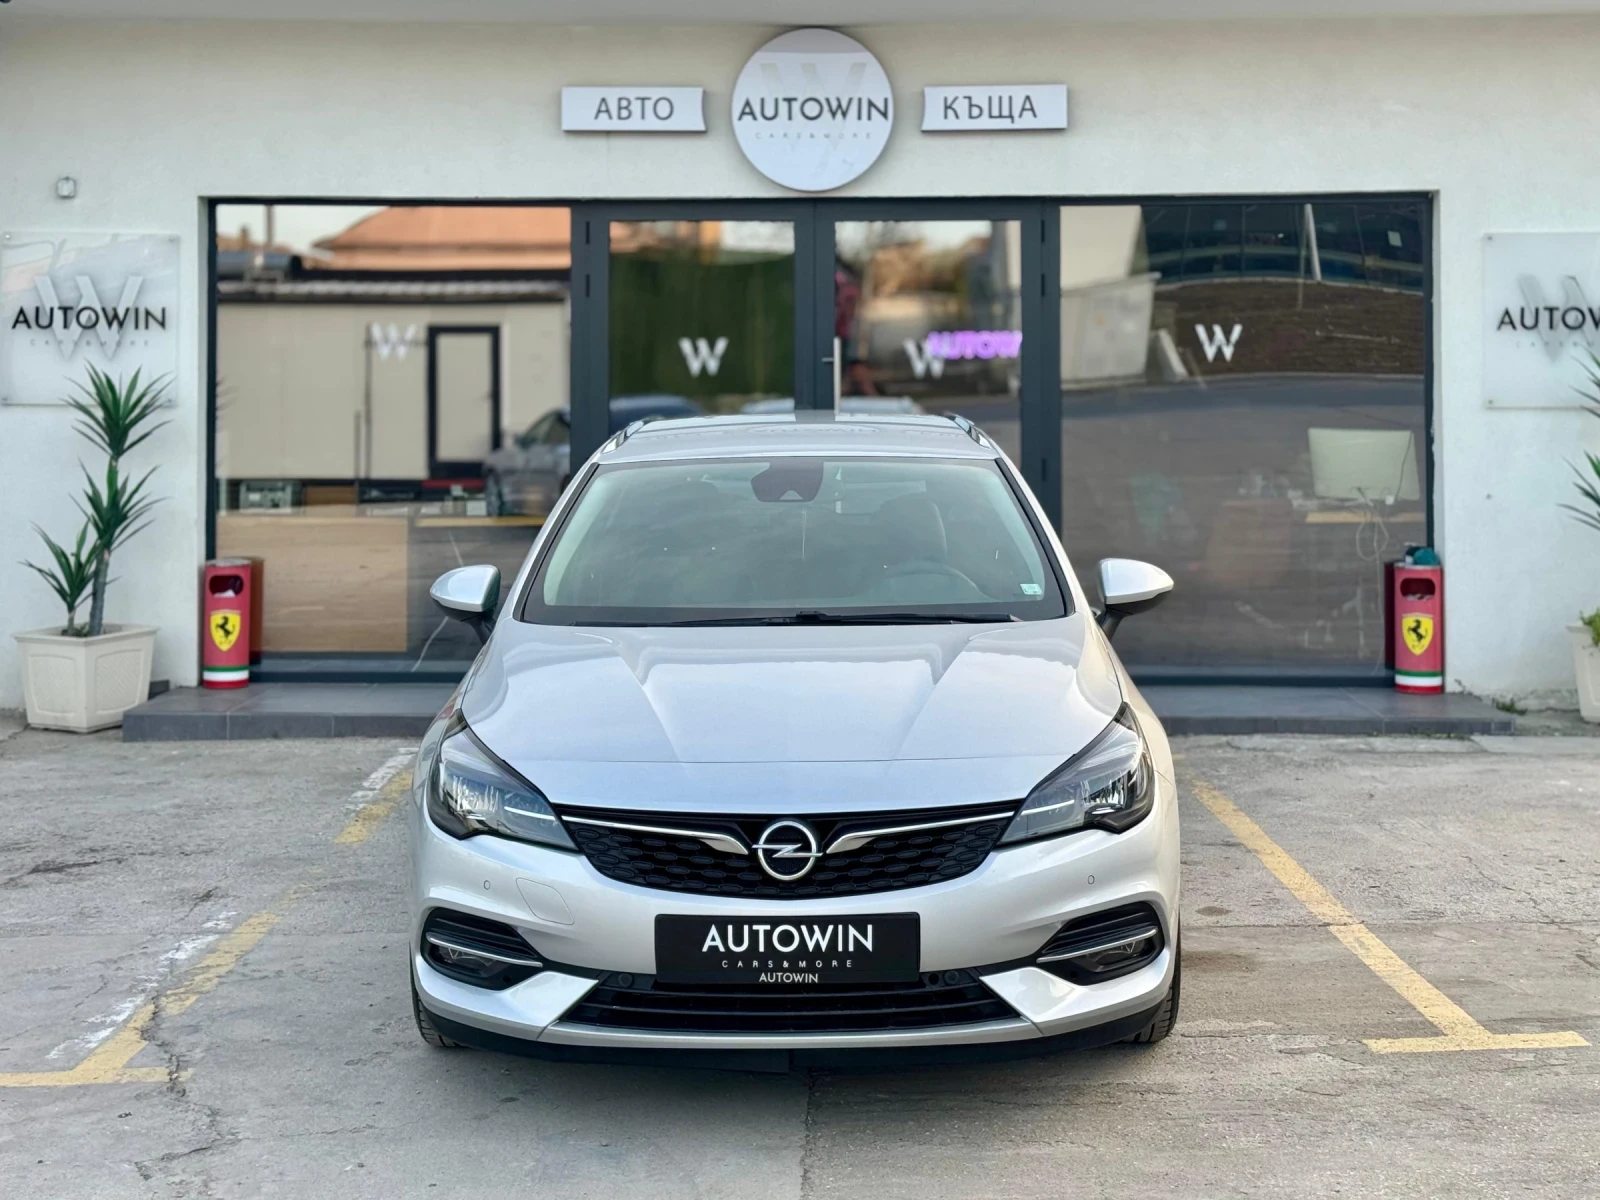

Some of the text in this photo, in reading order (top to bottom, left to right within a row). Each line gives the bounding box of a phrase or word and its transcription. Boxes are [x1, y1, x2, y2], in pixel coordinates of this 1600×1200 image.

[594, 96, 674, 121] АВТО
[737, 97, 889, 121] AUTOWIN
[943, 94, 1037, 124] КЪЩА
[11, 306, 166, 331] AUTOWIN
[1194, 323, 1243, 363] W
[679, 336, 729, 378] W
[702, 924, 873, 952] AUTOWIN
[721, 960, 852, 968] CARS&MORE
[759, 972, 819, 984] AUTOWIN
